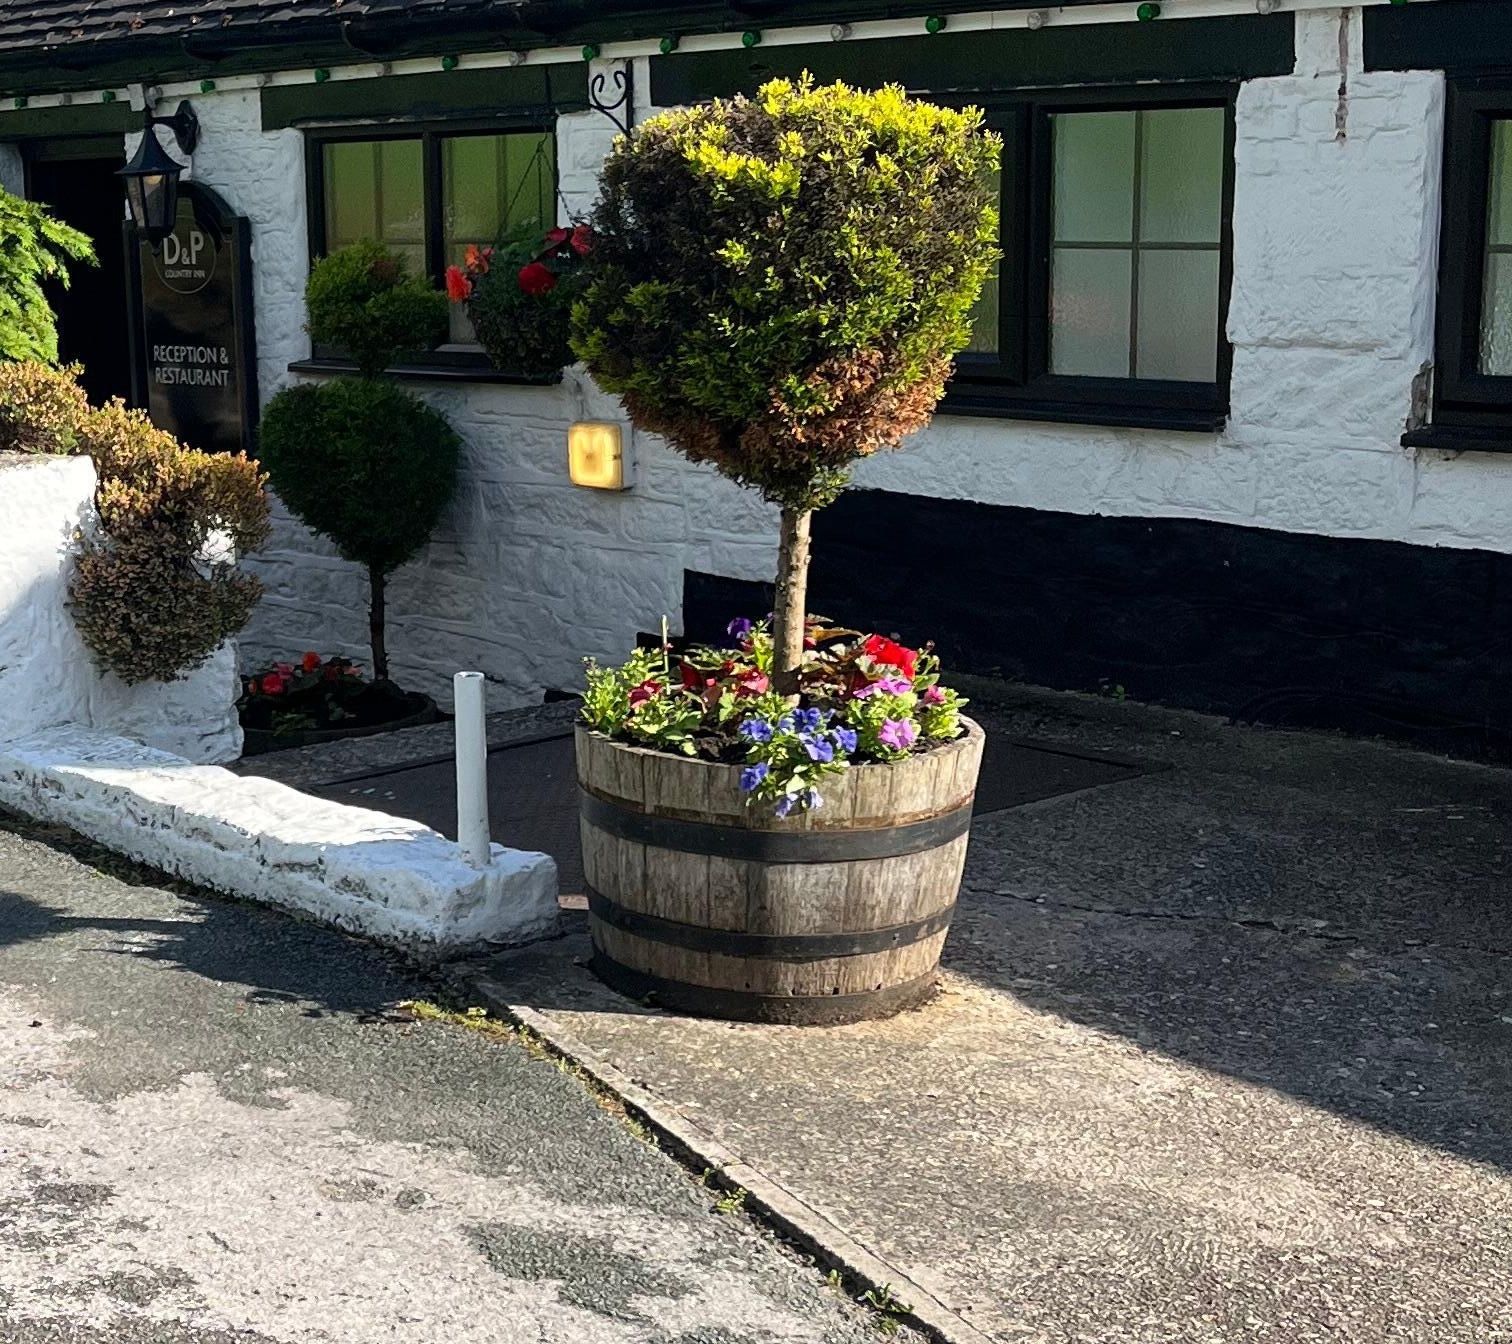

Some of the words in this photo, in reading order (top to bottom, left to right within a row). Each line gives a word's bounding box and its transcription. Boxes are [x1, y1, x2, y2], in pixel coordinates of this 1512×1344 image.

[163, 231, 204, 265] D&P
[153, 345, 217, 364] RECEPTION
[220, 347, 228, 364] &
[155, 367, 229, 386] RESTAURANT
